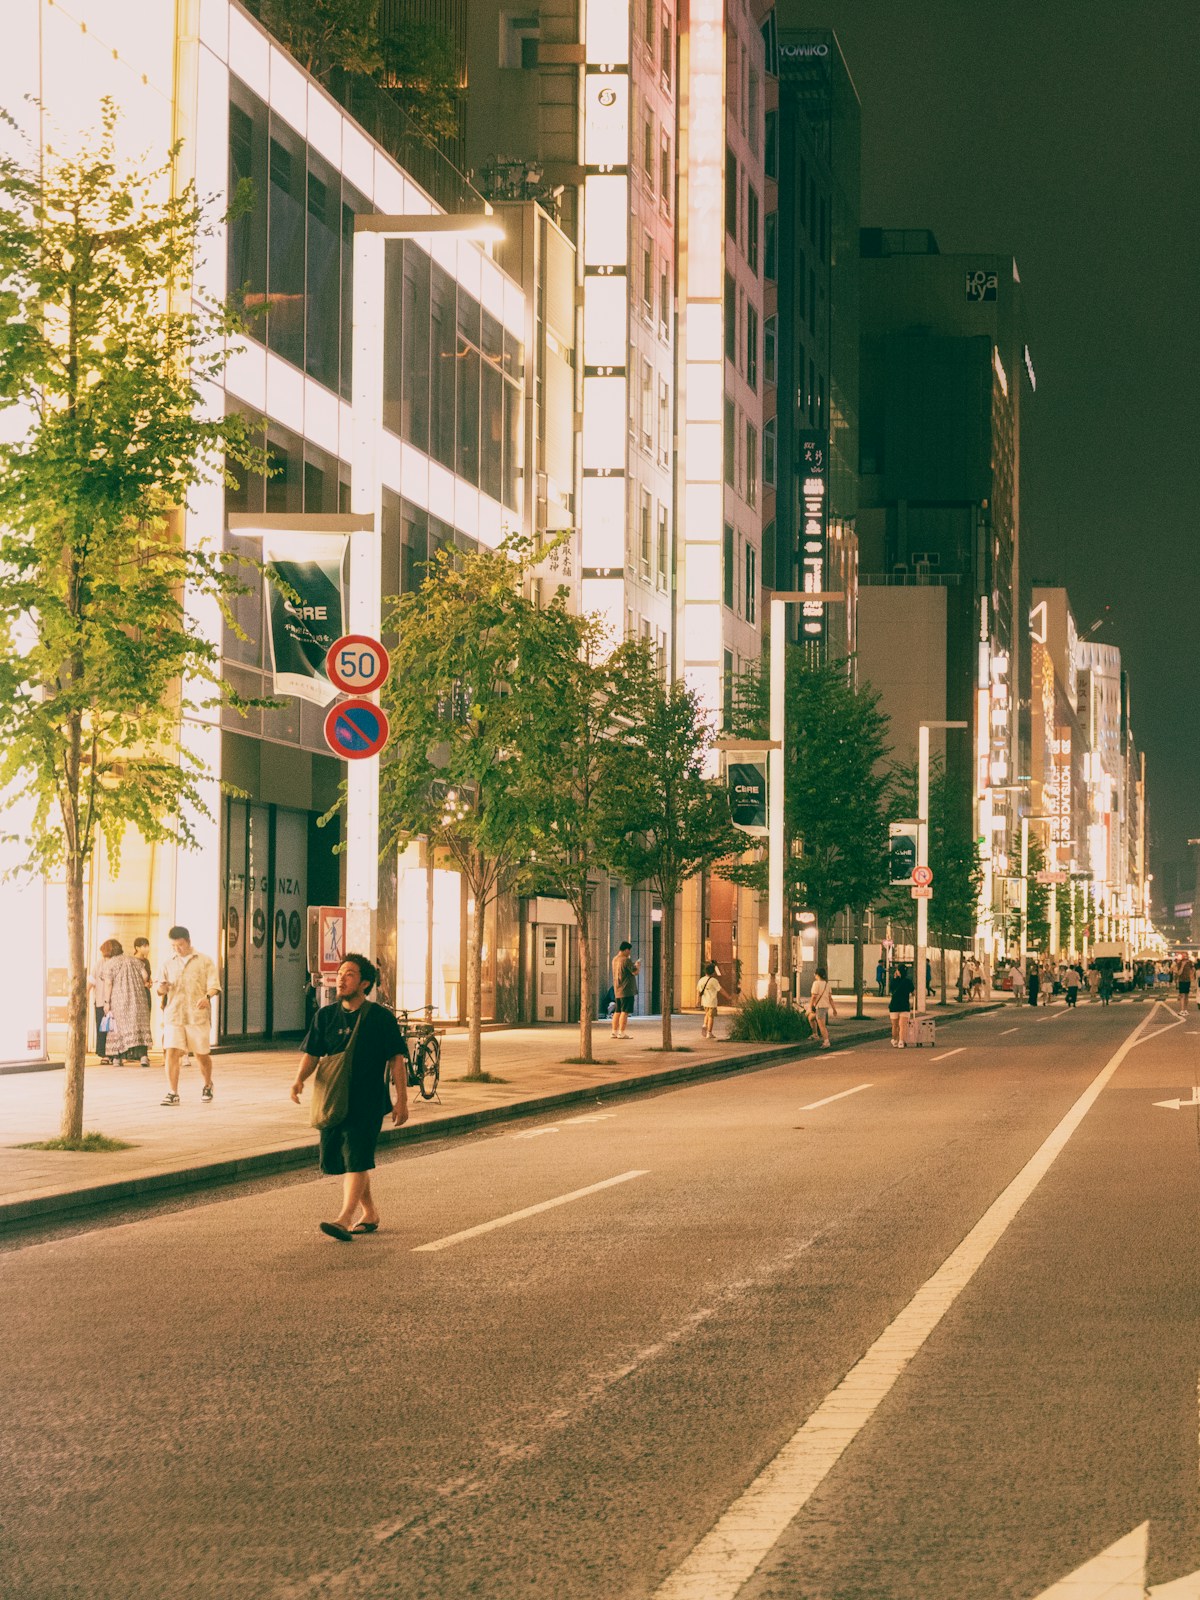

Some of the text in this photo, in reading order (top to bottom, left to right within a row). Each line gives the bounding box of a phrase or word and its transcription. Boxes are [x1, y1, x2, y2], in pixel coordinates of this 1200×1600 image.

[779, 44, 829, 56] YOMIKO
[598, 265, 614, 275] 4F
[340, 651, 375, 679] 50
